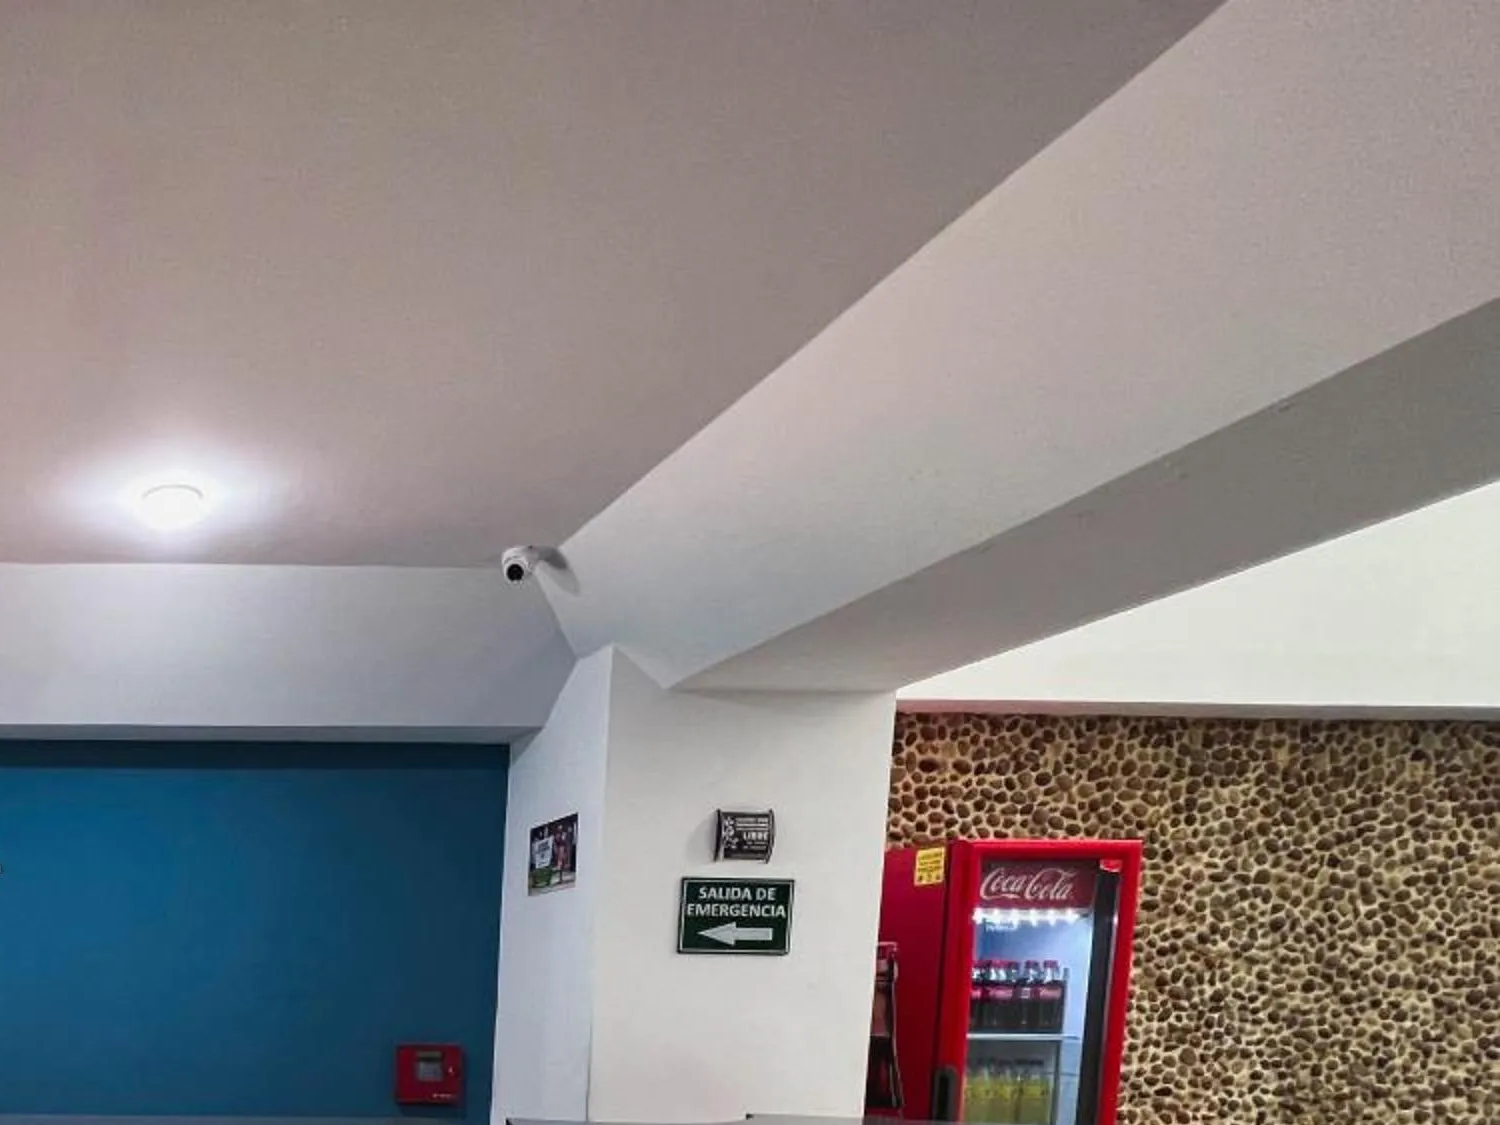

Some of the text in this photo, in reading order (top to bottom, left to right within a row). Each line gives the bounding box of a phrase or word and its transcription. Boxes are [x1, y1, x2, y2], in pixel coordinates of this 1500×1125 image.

[698, 887, 777, 901] SALIDA DE
[686, 903, 787, 918] EMERGENCIA
